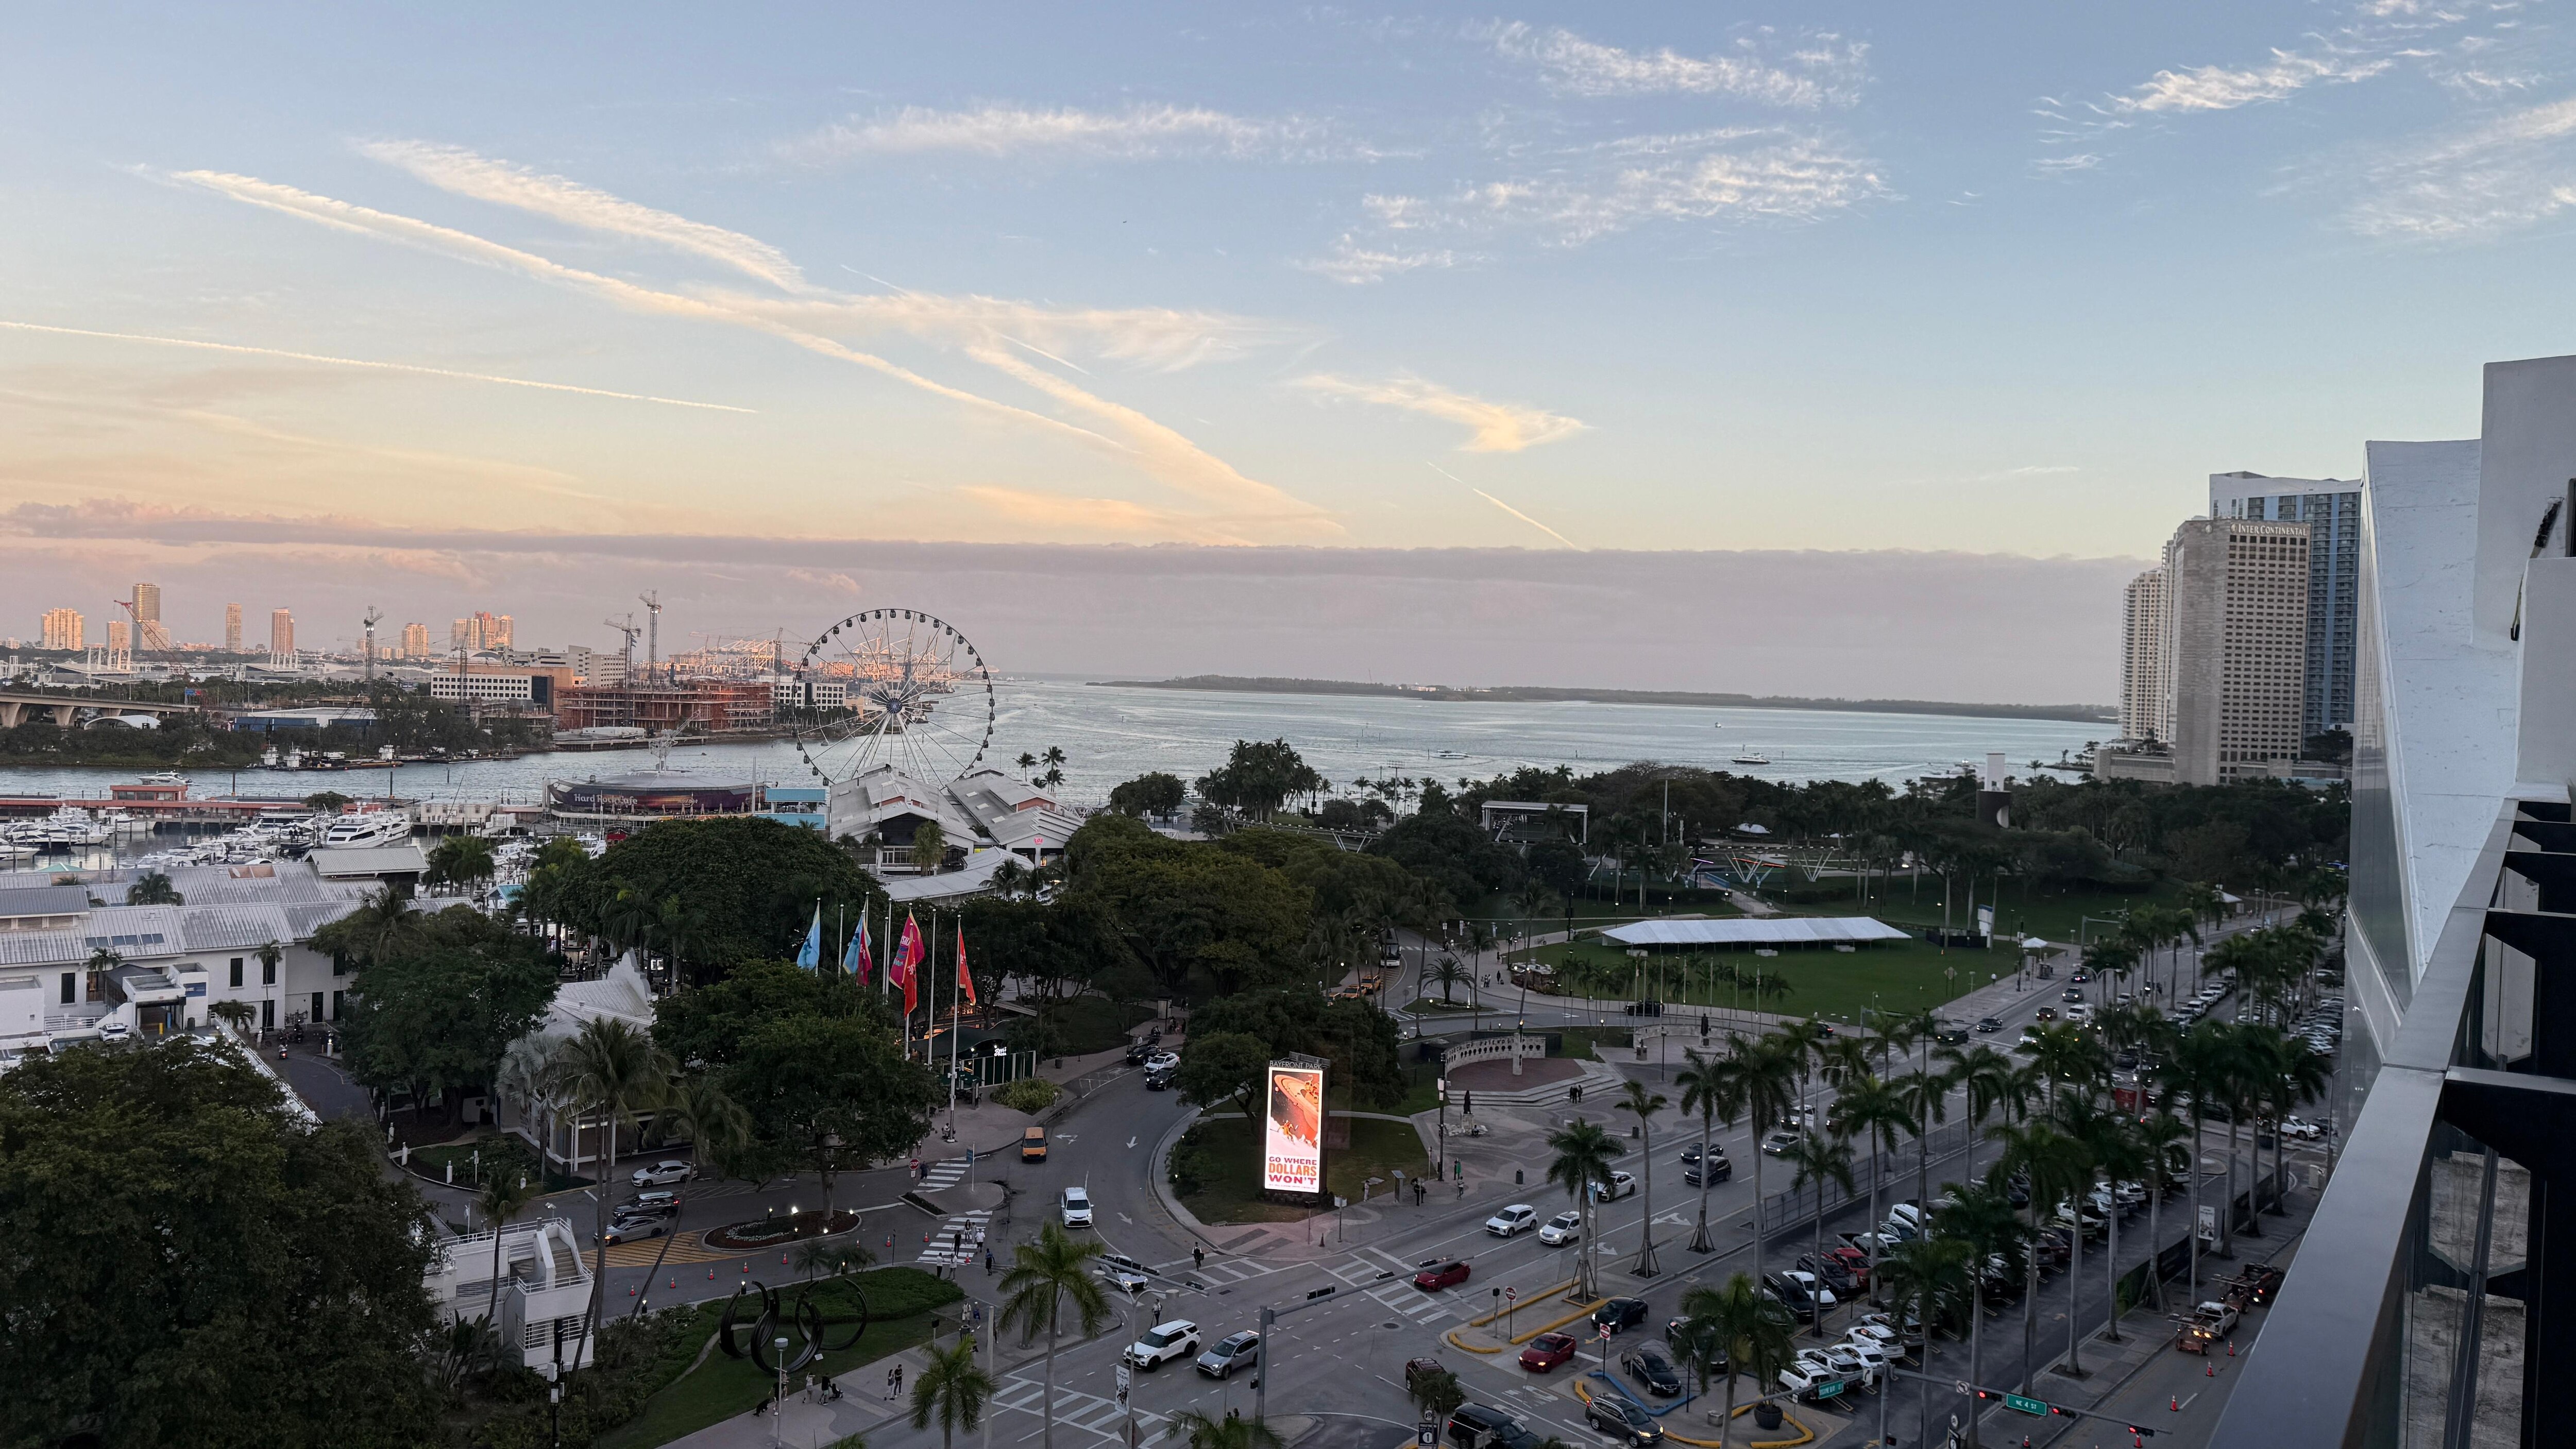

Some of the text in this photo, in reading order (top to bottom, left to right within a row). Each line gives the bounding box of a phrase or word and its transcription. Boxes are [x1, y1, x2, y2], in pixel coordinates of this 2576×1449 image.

[573, 793, 595, 803] Hard
[596, 794, 618, 805] Rock
[1269, 1060, 1303, 1069] BAYFRONT
[1268, 1163, 1317, 1177] DOLLARS
[1268, 1174, 1316, 1185] WON'T
